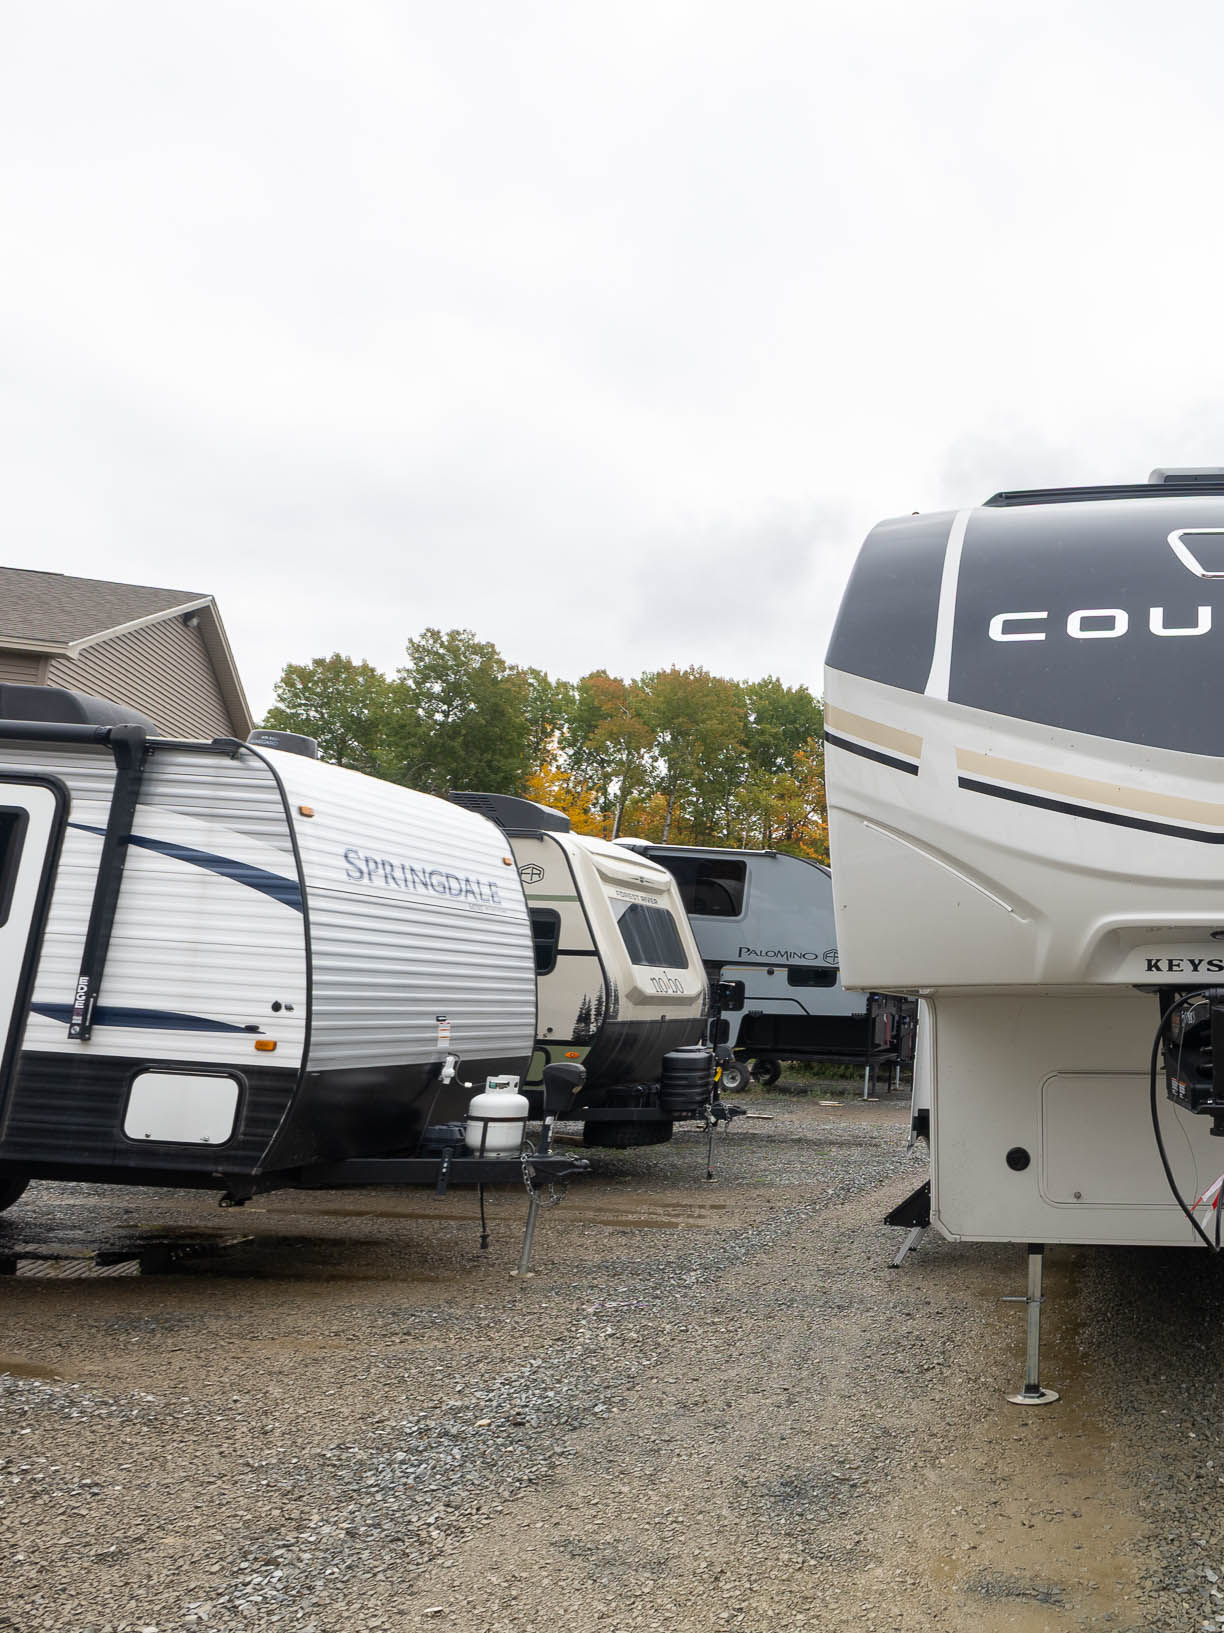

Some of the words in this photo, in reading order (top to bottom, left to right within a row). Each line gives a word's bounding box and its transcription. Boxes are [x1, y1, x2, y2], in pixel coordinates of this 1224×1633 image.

[344, 848, 502, 905] SPRINGDALE
[737, 946, 818, 961] PALOMINO
[74, 977, 89, 1008] EDGE
